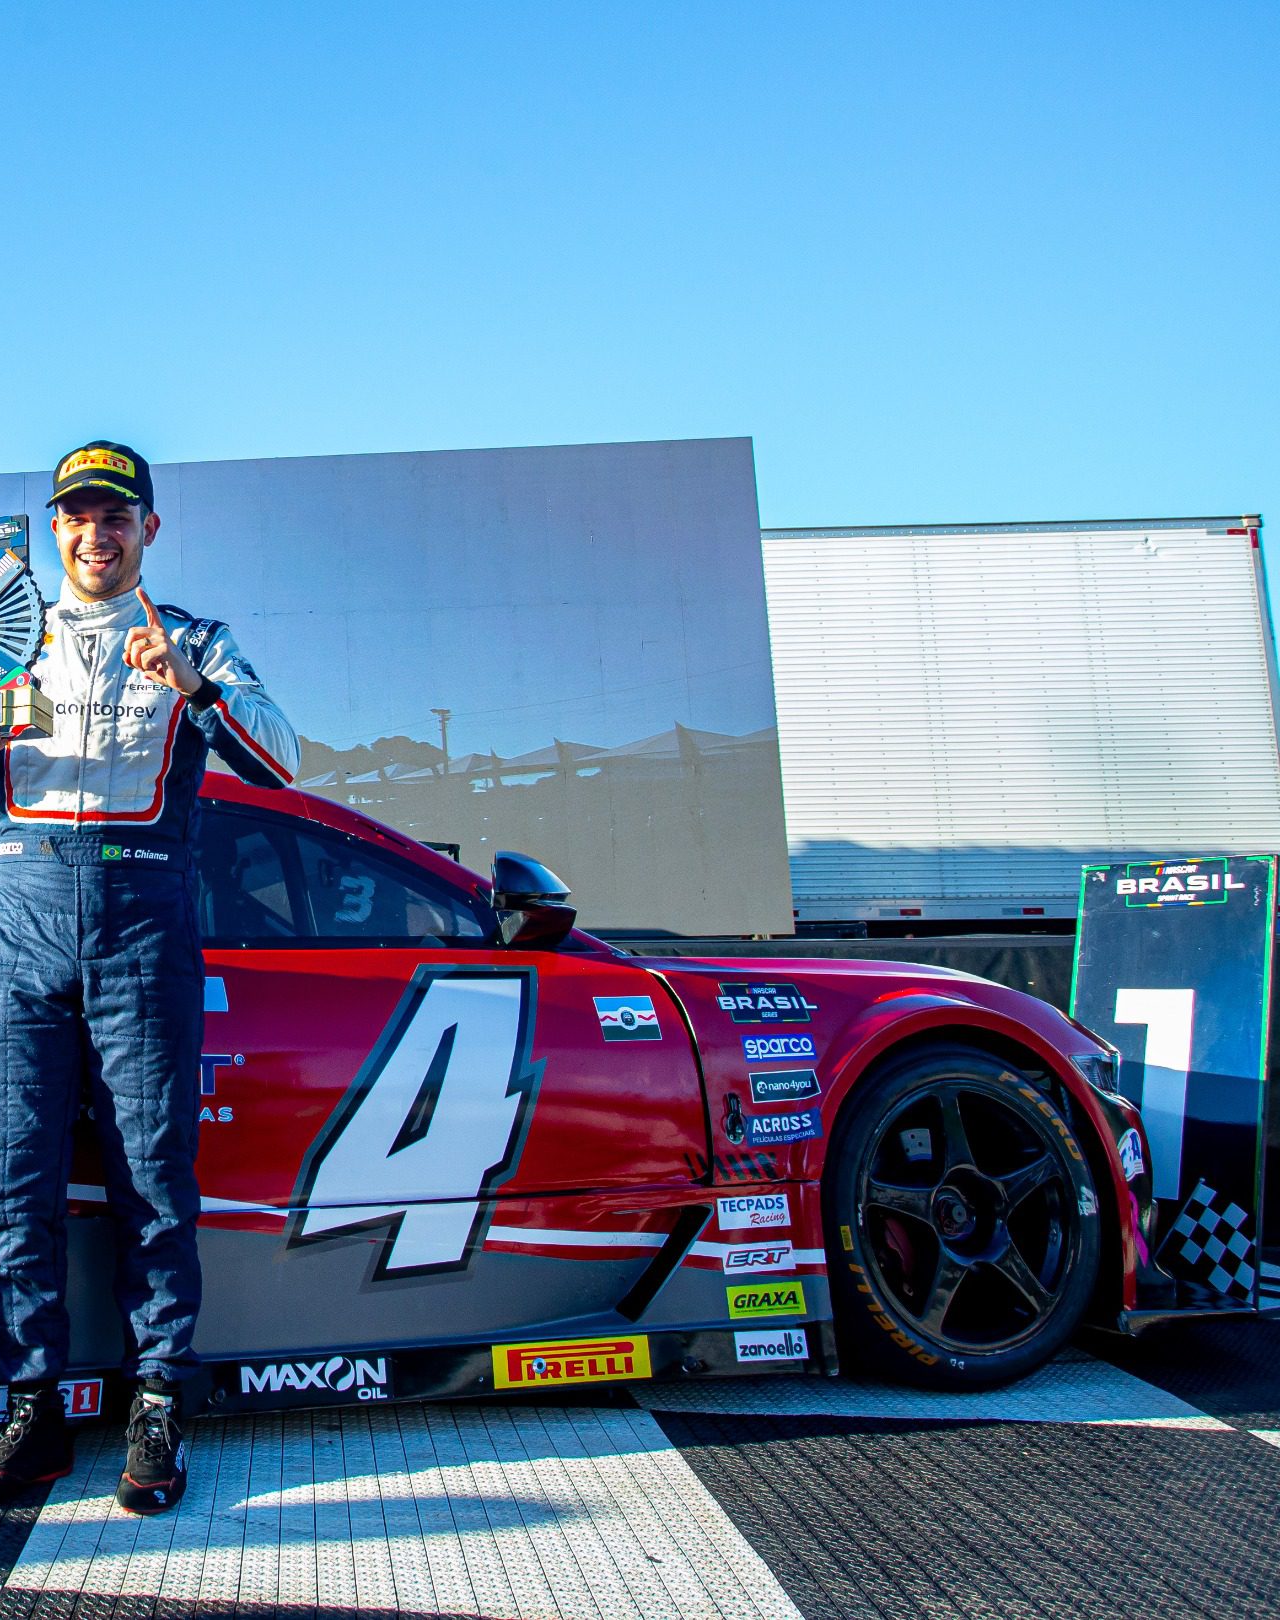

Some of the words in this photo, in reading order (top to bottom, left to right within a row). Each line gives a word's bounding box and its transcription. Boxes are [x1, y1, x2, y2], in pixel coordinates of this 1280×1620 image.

[122, 848, 132, 858] C.
[134, 849, 169, 861] Chianca
[1163, 865, 1198, 875] NASCAR
[1117, 873, 1245, 895] BRASIL
[752, 987, 777, 995] NASCAR
[718, 996, 818, 1010] BRASIL
[745, 1037, 813, 1059] sparco
[768, 1080, 812, 1091] nano4you
[1114, 988, 1195, 1200] 1
[287, 971, 535, 1282] 4
[752, 1113, 812, 1134] ACROSS
[720, 1197, 785, 1213] TECPADS
[750, 1213, 786, 1226] Racing
[726, 1247, 791, 1268] ERT
[733, 1291, 798, 1309] GRAXA
[739, 1332, 803, 1357] zanoello
[507, 1341, 635, 1383] PIRELLI
[240, 1356, 388, 1393] MAXON
[357, 1388, 388, 1400] OIL
